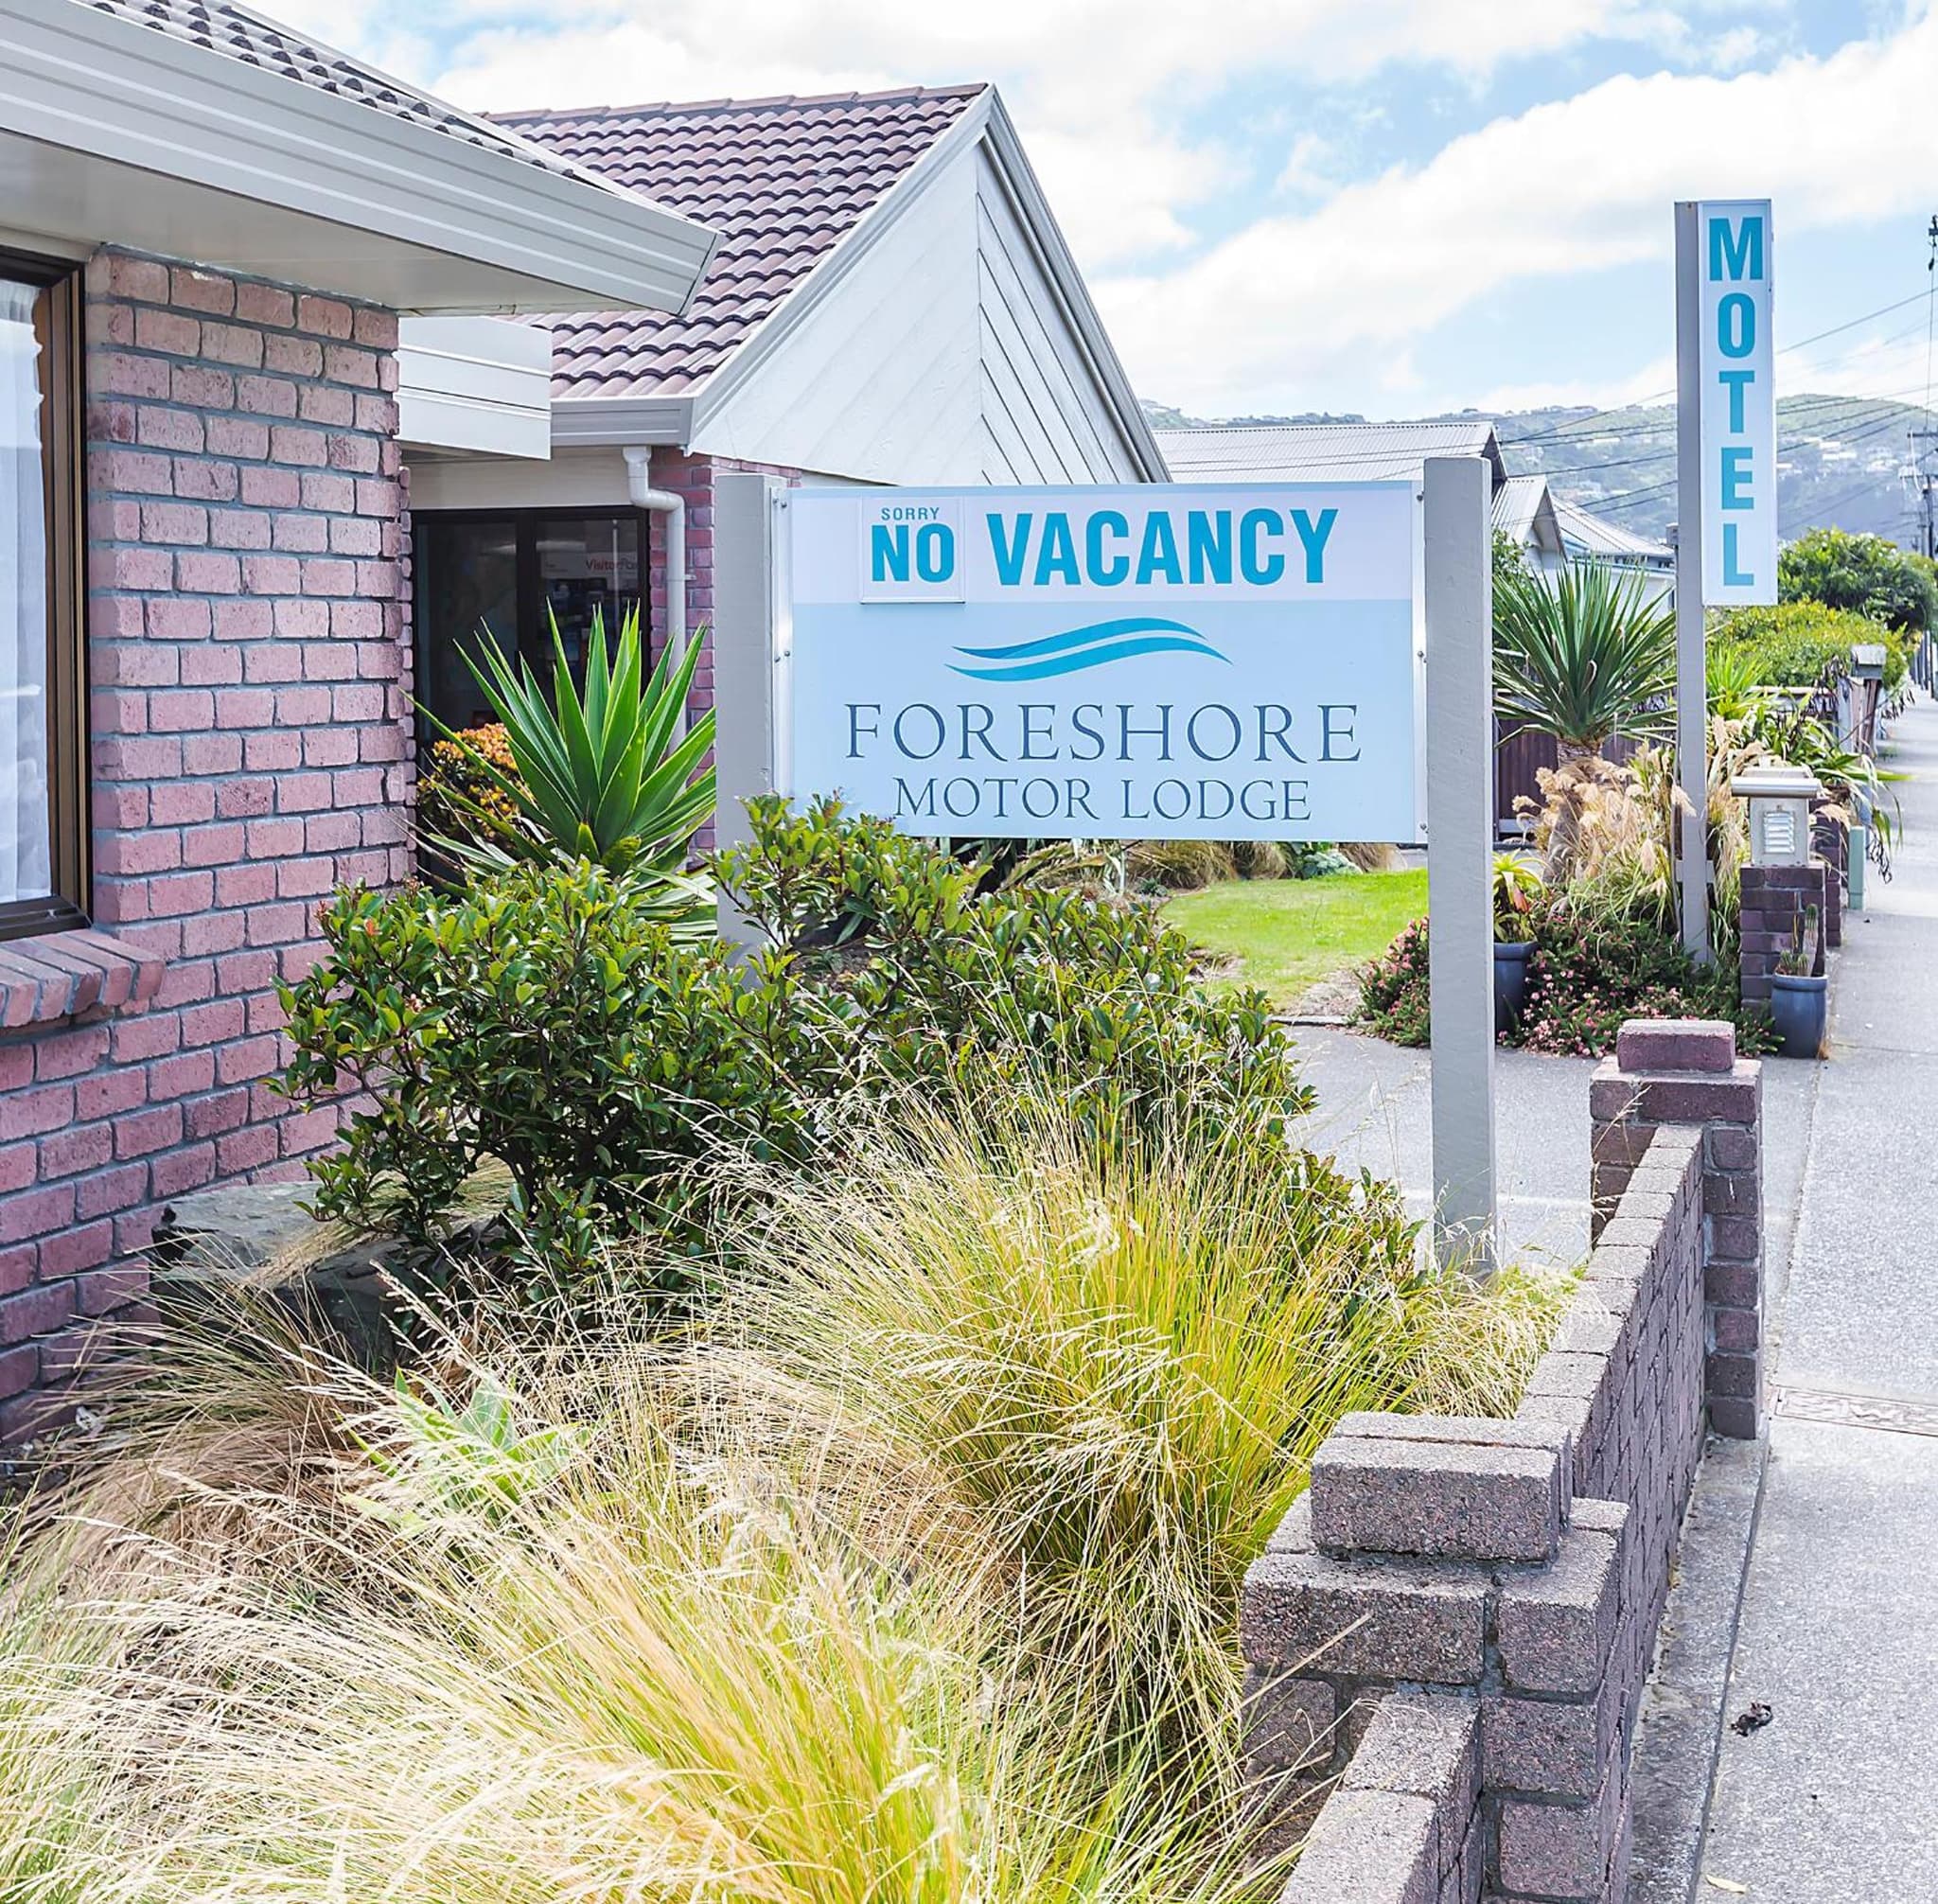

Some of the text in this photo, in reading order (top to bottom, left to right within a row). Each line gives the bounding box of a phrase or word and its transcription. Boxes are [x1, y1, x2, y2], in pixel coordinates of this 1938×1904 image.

[1709, 217, 1763, 586] MOTEL
[882, 506, 939, 521] SORRY
[871, 508, 1339, 586] NO VACANCY
[845, 703, 1361, 762] FORESHORE
[894, 777, 1311, 821] MOTOR LODGE
